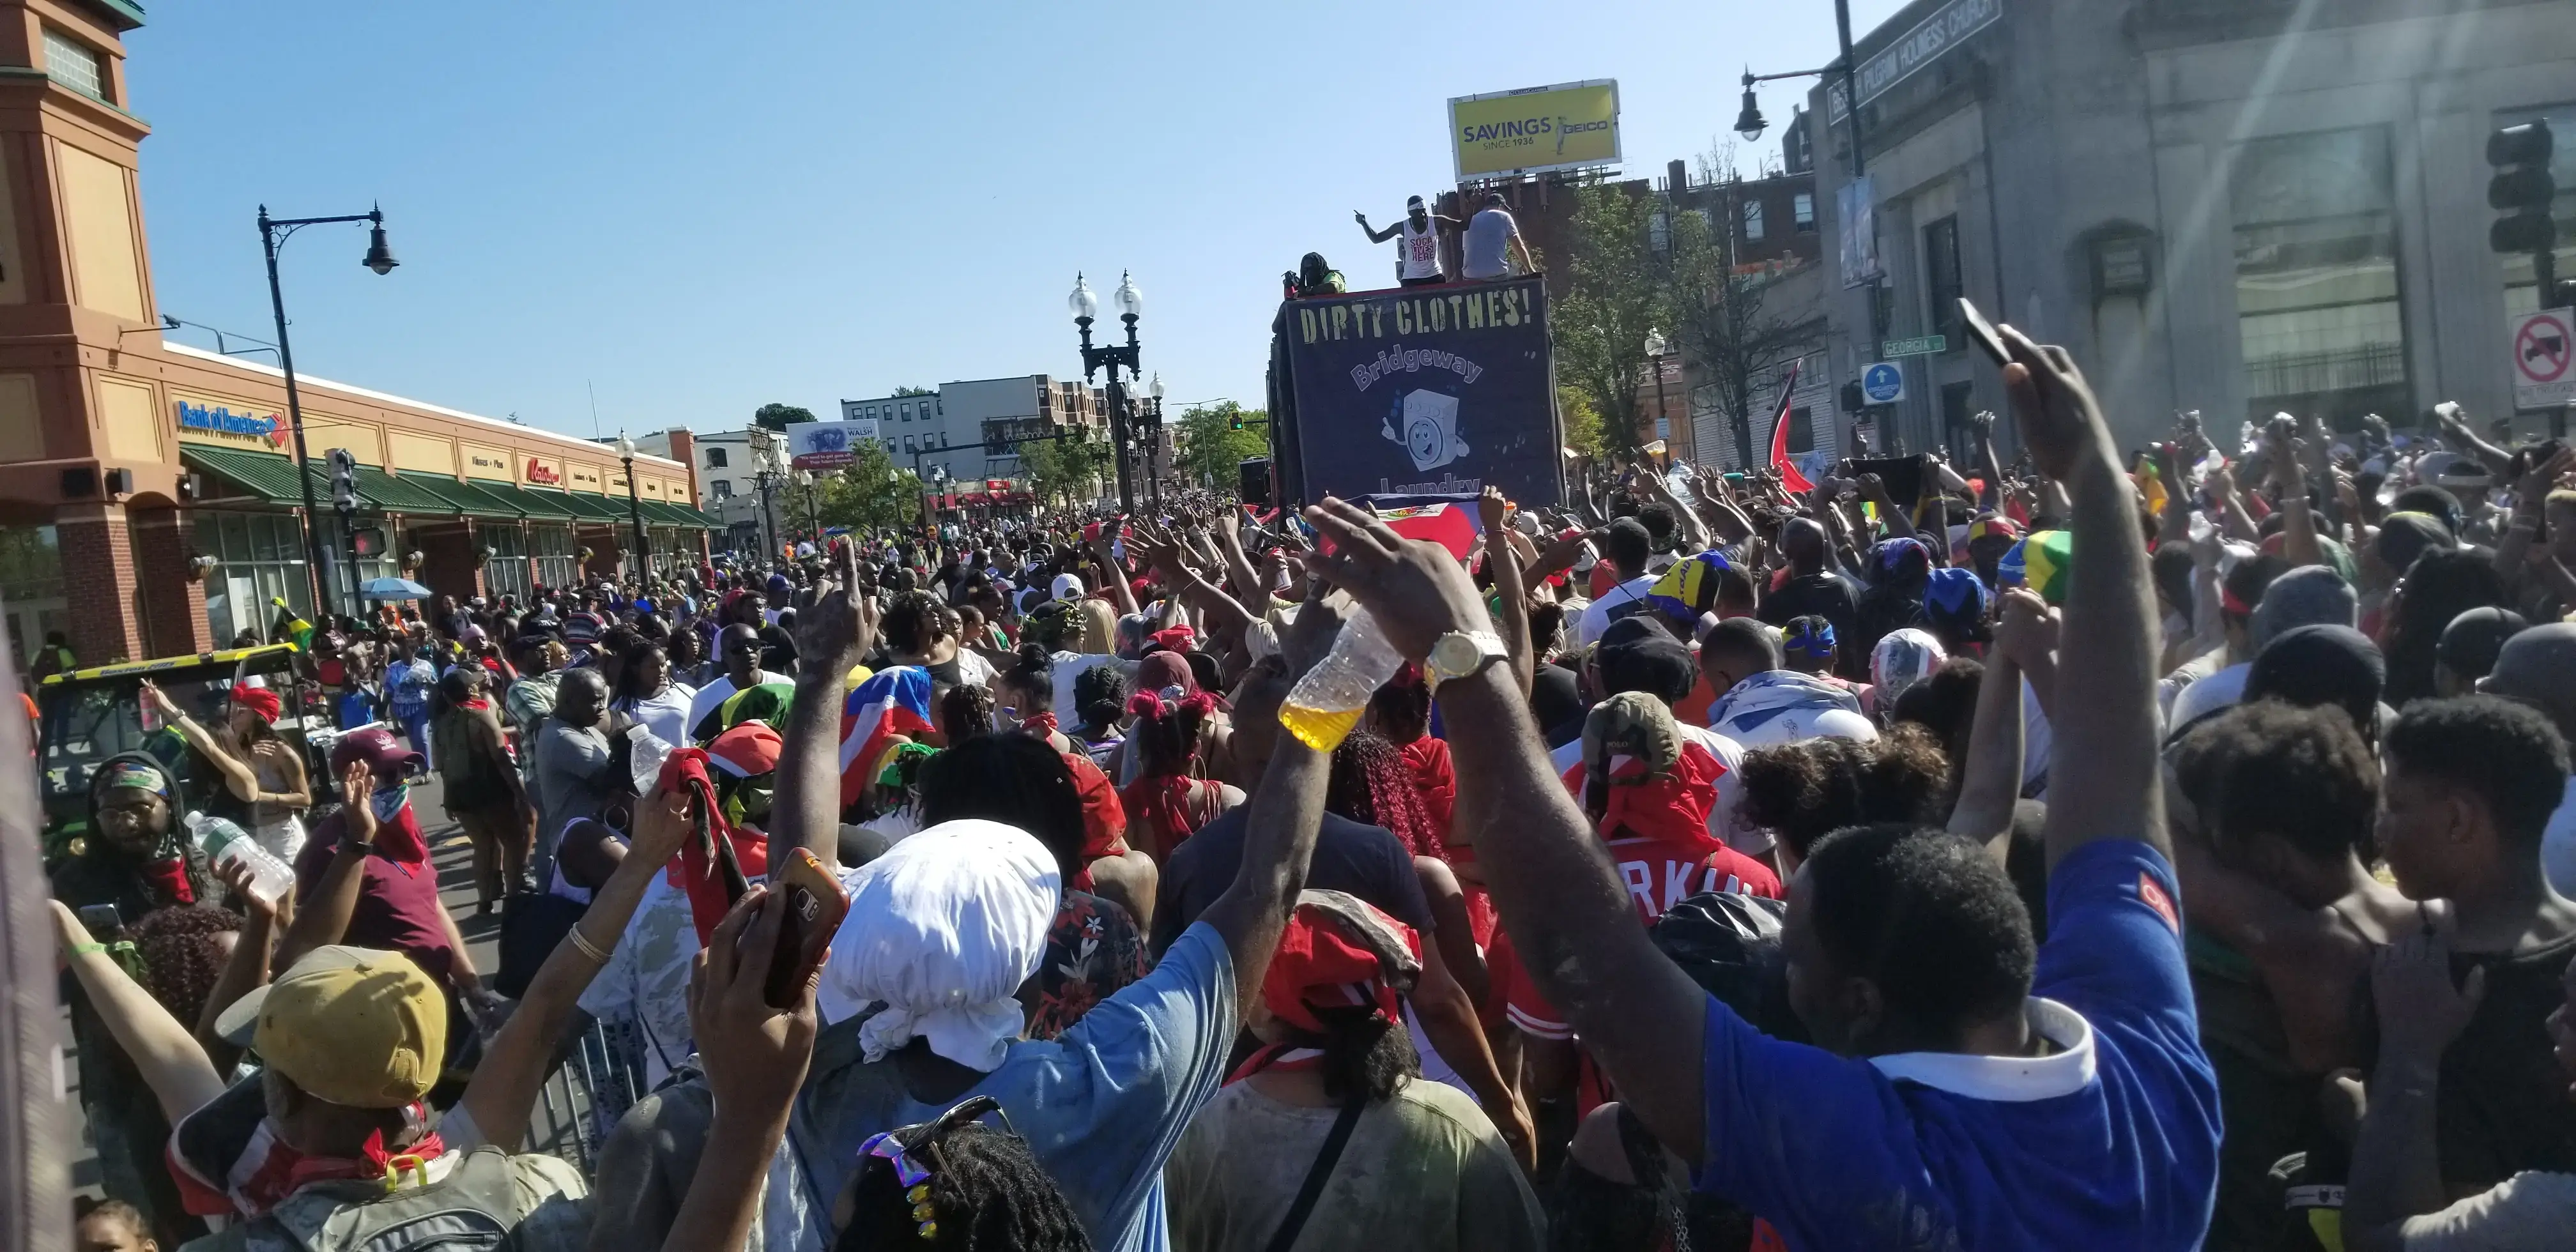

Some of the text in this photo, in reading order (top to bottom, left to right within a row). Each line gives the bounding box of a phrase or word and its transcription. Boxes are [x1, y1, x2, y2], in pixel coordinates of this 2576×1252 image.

[1899, 19, 1945, 70] HOLINESS
[1463, 117, 1552, 142] SAVINGS
[1564, 121, 1608, 134] GEICO
[1483, 137, 1534, 150] SINCE 1936
[1410, 236, 1433, 246] SOCA
[1411, 245, 1434, 254] LIVES
[1412, 252, 1434, 261] HERE
[1300, 287, 1531, 344] DIRTY CLOTHES!
[1885, 339, 1930, 355] GEORGIA
[1350, 344, 1483, 392] Bridgeway
[178, 401, 267, 436] Bank of America
[1380, 473, 1481, 494] Laundry
